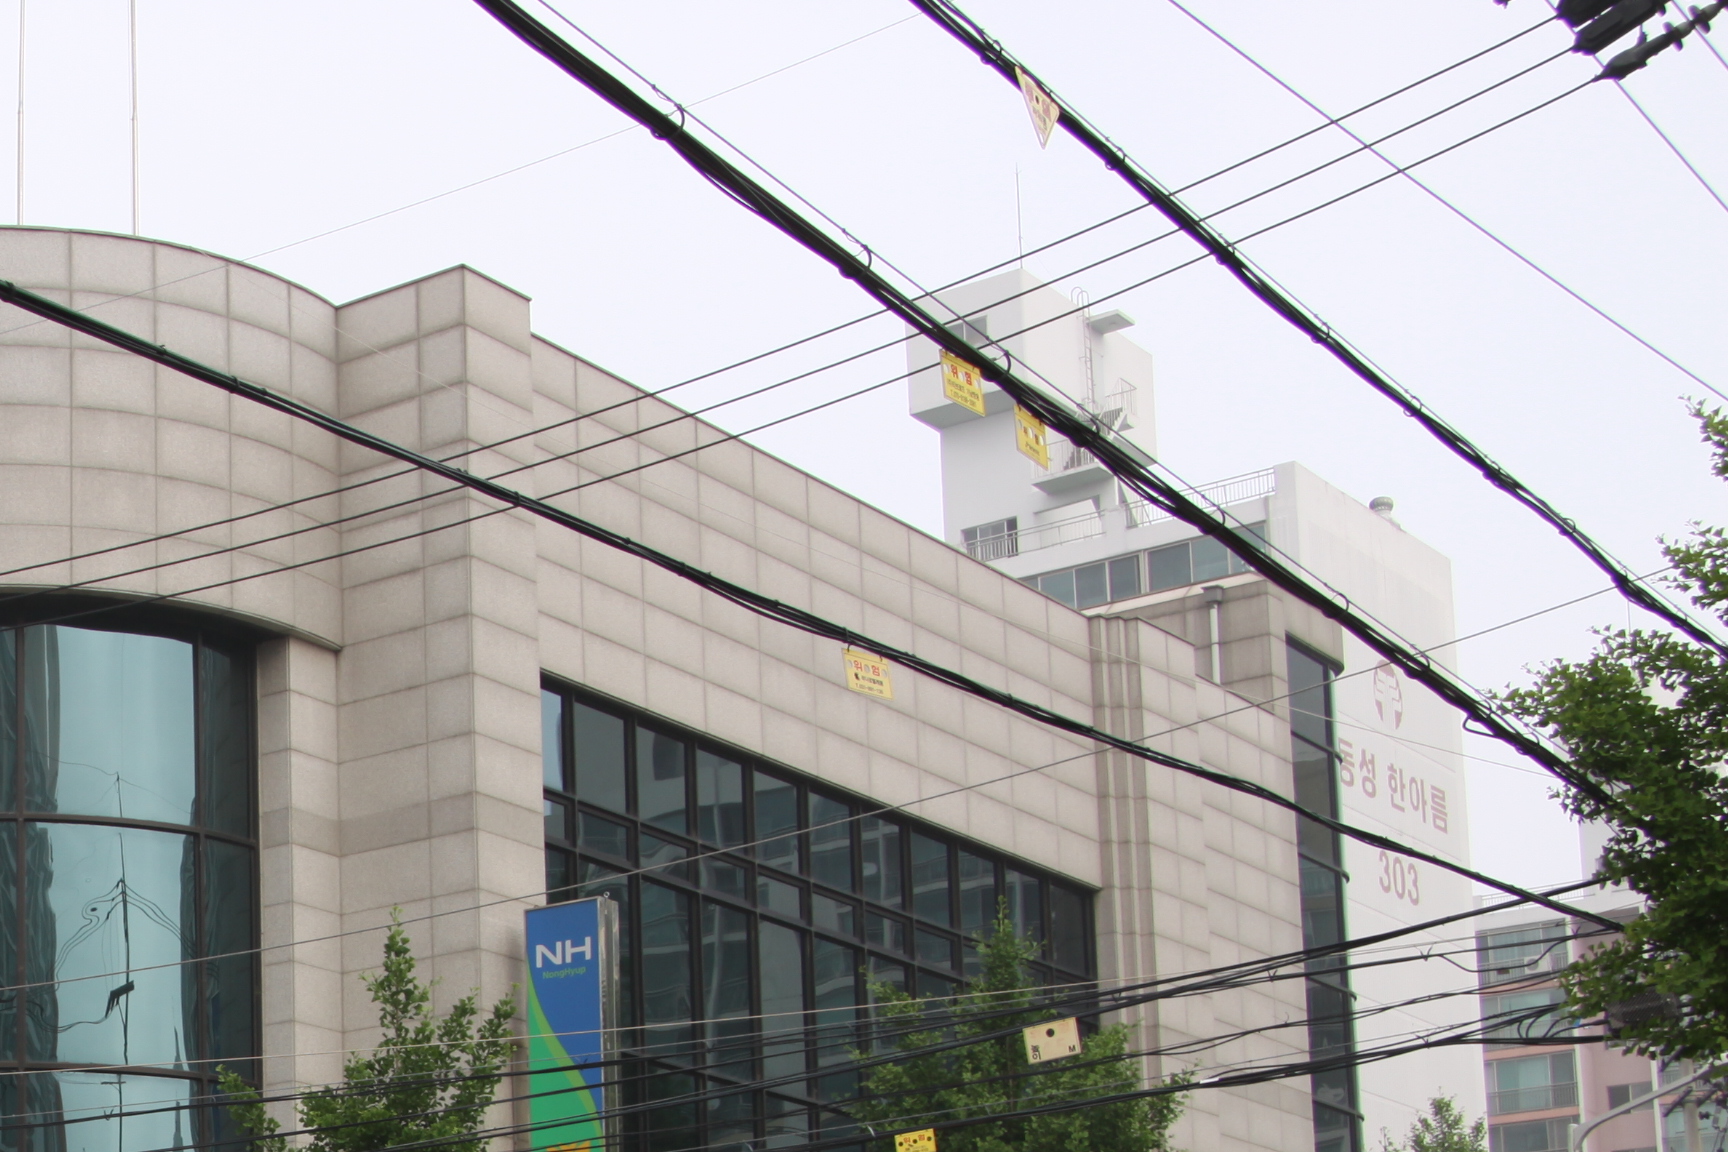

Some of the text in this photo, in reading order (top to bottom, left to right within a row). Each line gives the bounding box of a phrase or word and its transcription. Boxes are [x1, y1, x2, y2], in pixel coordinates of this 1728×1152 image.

[853, 660, 880, 677] 위험
[1338, 736, 1449, 835] 동성 한아름
[1378, 849, 1420, 906] 303
[535, 936, 592, 969] NH
[541, 965, 587, 981] NongHyup
[1068, 1044, 1076, 1053] M
